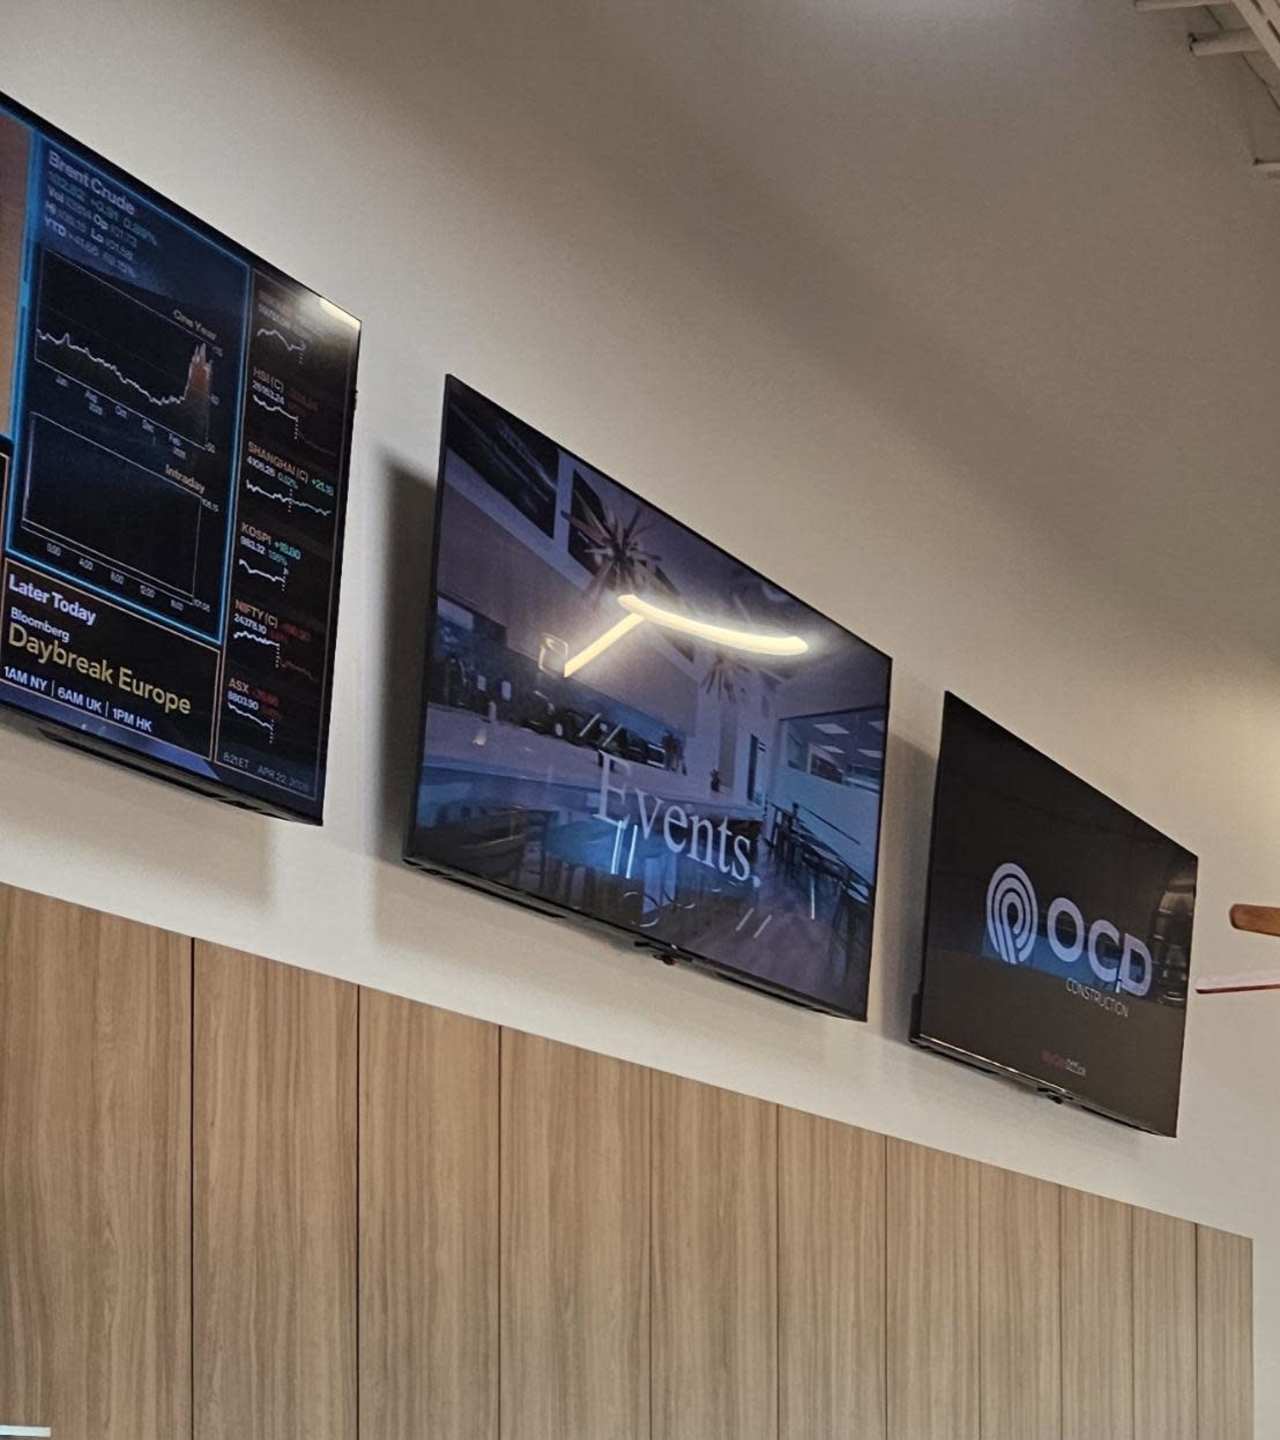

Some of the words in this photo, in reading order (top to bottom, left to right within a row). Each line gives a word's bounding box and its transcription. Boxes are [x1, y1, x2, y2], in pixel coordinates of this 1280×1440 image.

[49, 150, 90, 188] Brent
[91, 178, 135, 215] Crude
[248, 441, 296, 476] SHANGHAI
[240, 522, 272, 545] KOSPI
[9, 574, 50, 604] Later
[50, 590, 97, 626] Today
[11, 606, 70, 643] Bloomberg
[8, 622, 114, 685] Daybreak
[118, 666, 192, 715] Europe
[228, 677, 249, 694] ASX
[4, 665, 28, 684] 1AM
[30, 676, 48, 692] NY
[57, 686, 85, 706] 6AM
[86, 697, 103, 714] UK
[112, 708, 136, 727] 1PM
[136, 716, 152, 733] HK
[592, 749, 764, 888] Events.
[1046, 896, 1152, 996] OCD
